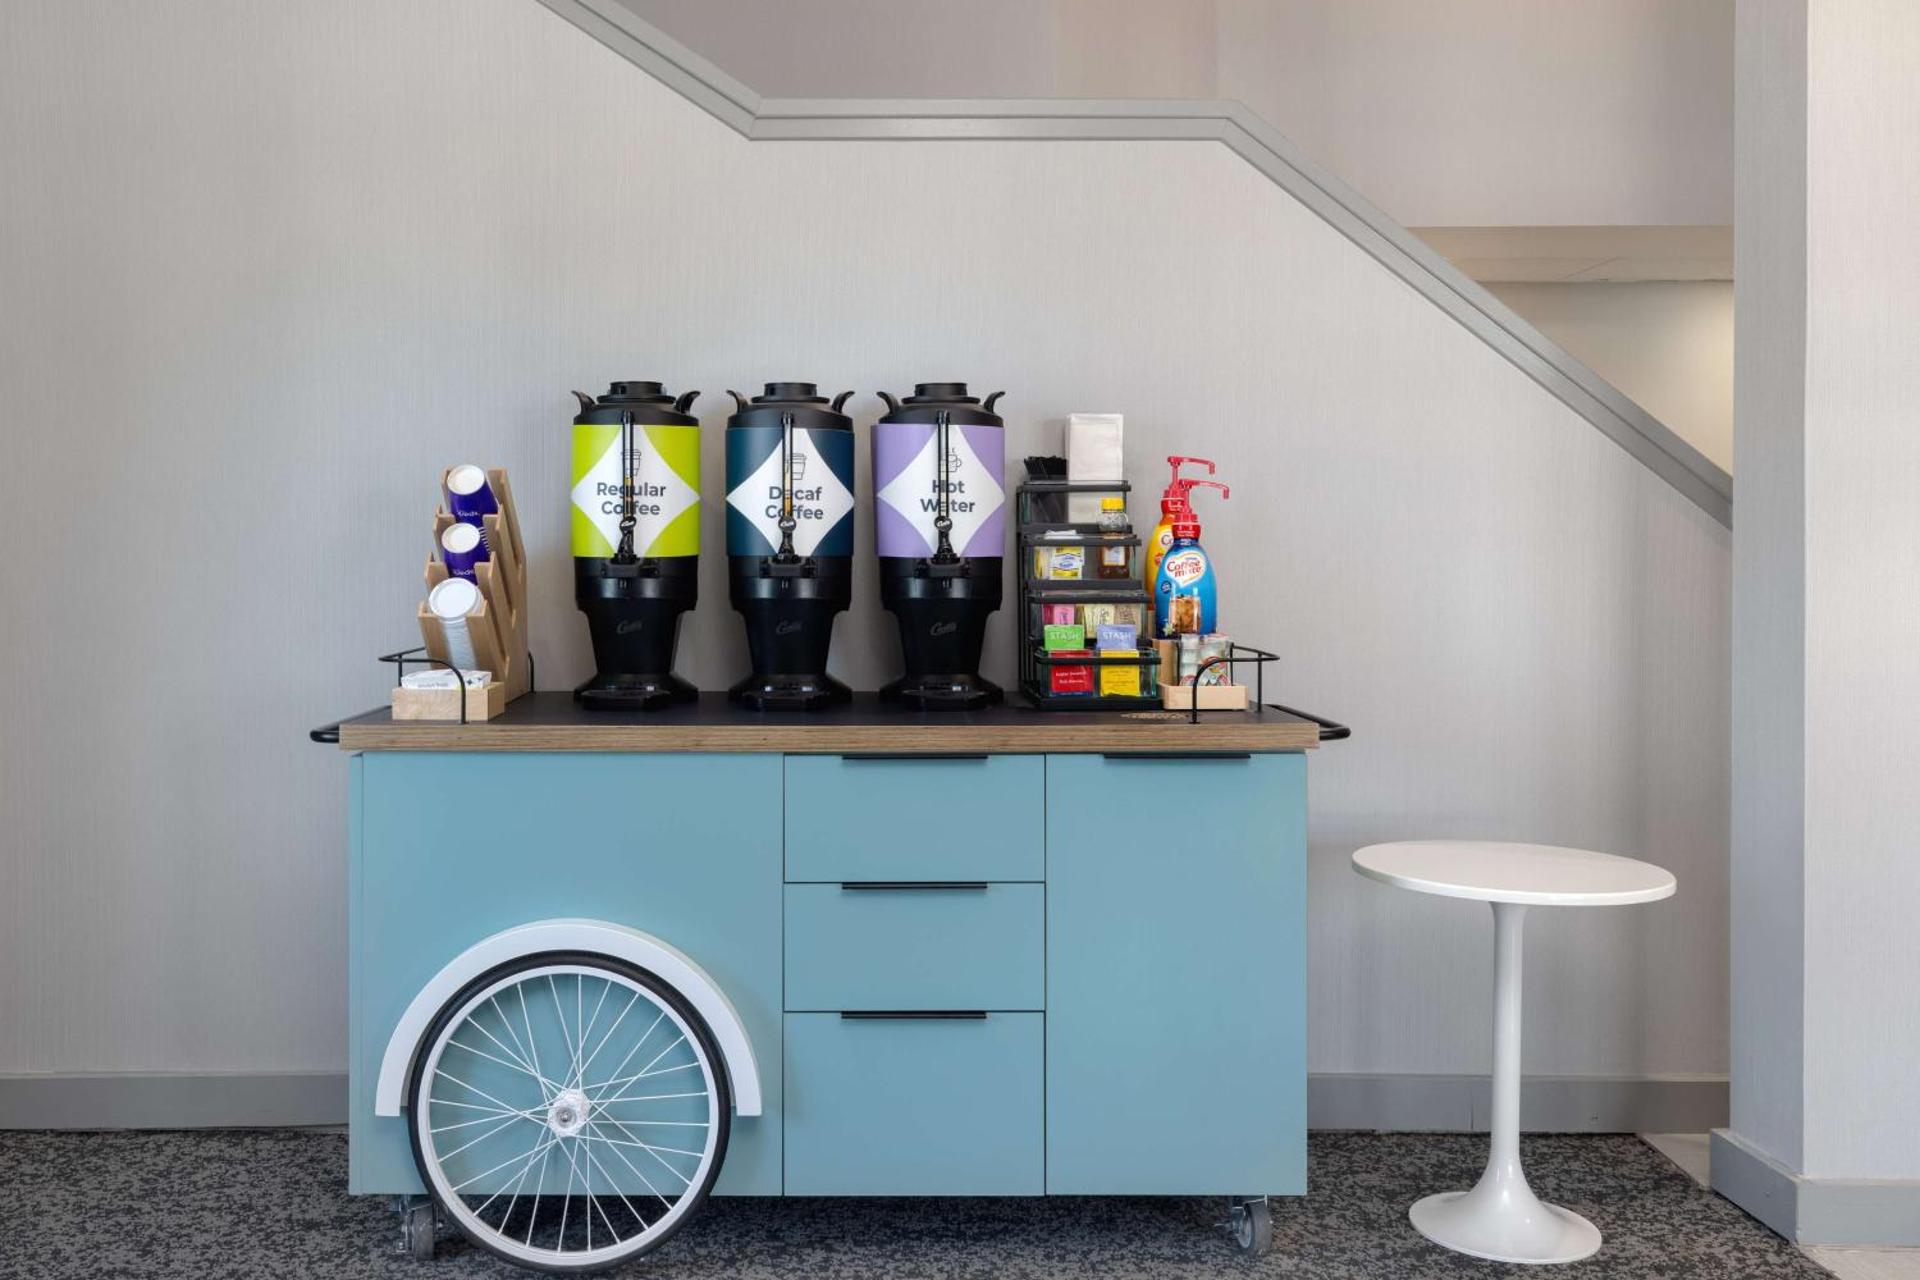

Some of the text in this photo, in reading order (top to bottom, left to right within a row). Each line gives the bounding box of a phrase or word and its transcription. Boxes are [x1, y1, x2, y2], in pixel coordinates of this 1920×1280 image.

[932, 480, 965, 493] Hot
[769, 486, 822, 501] Dcaf
[601, 501, 661, 515] Cofee
[1102, 631, 1131, 641] STASH
